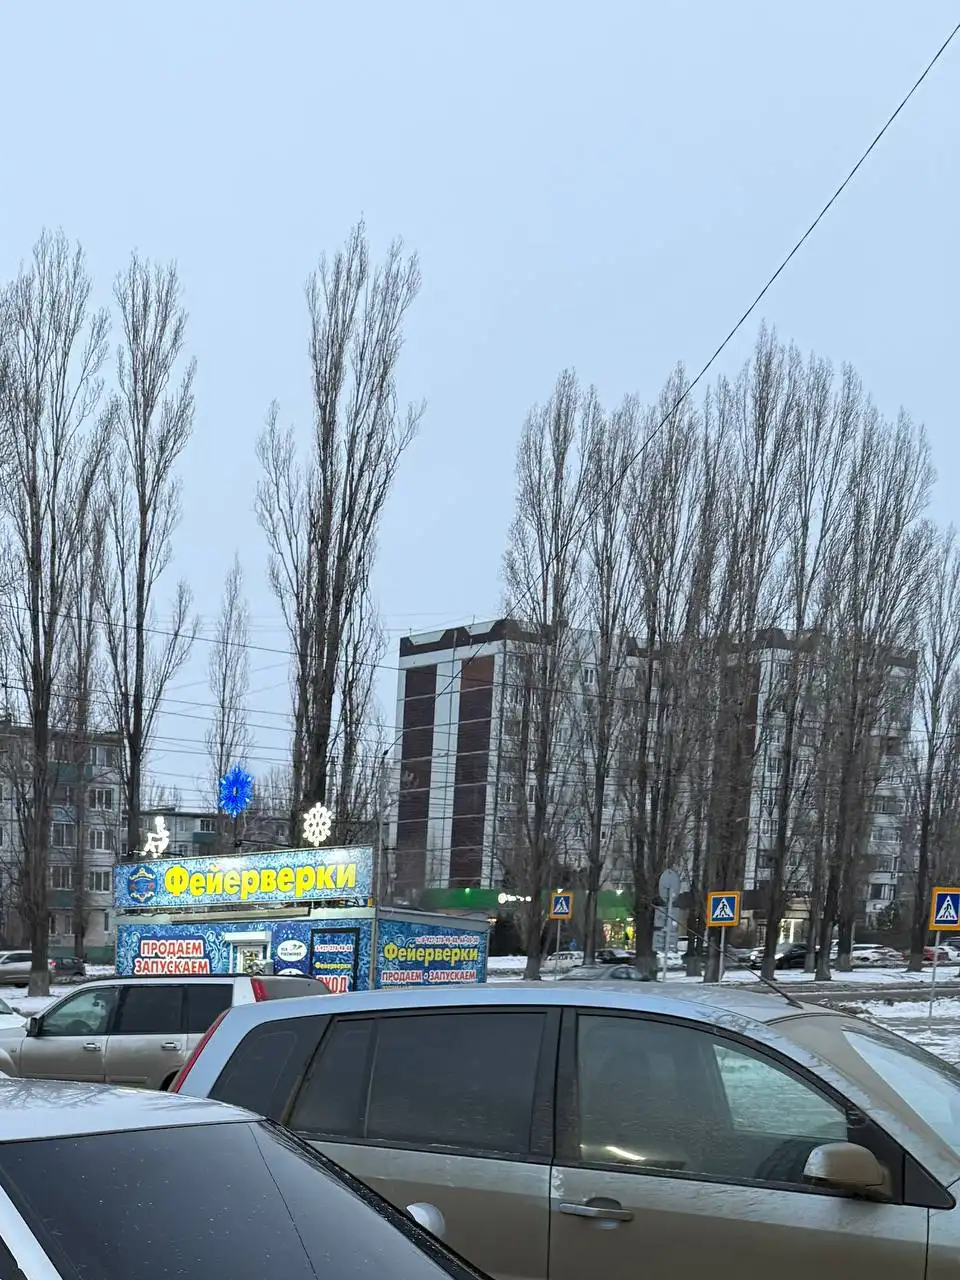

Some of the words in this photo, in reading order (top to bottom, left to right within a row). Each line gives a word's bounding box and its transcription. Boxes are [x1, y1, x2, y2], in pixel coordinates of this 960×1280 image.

[164, 863, 357, 899] Фейерверки
[141, 941, 203, 956] ПРОДАЕМ
[384, 942, 478, 967] Фейерверки
[134, 959, 209, 974] ЗАПУСКАЕМ
[382, 971, 422, 982] ПРОДАЕМ
[429, 970, 476, 981] ЗАПУСКАЕМ
